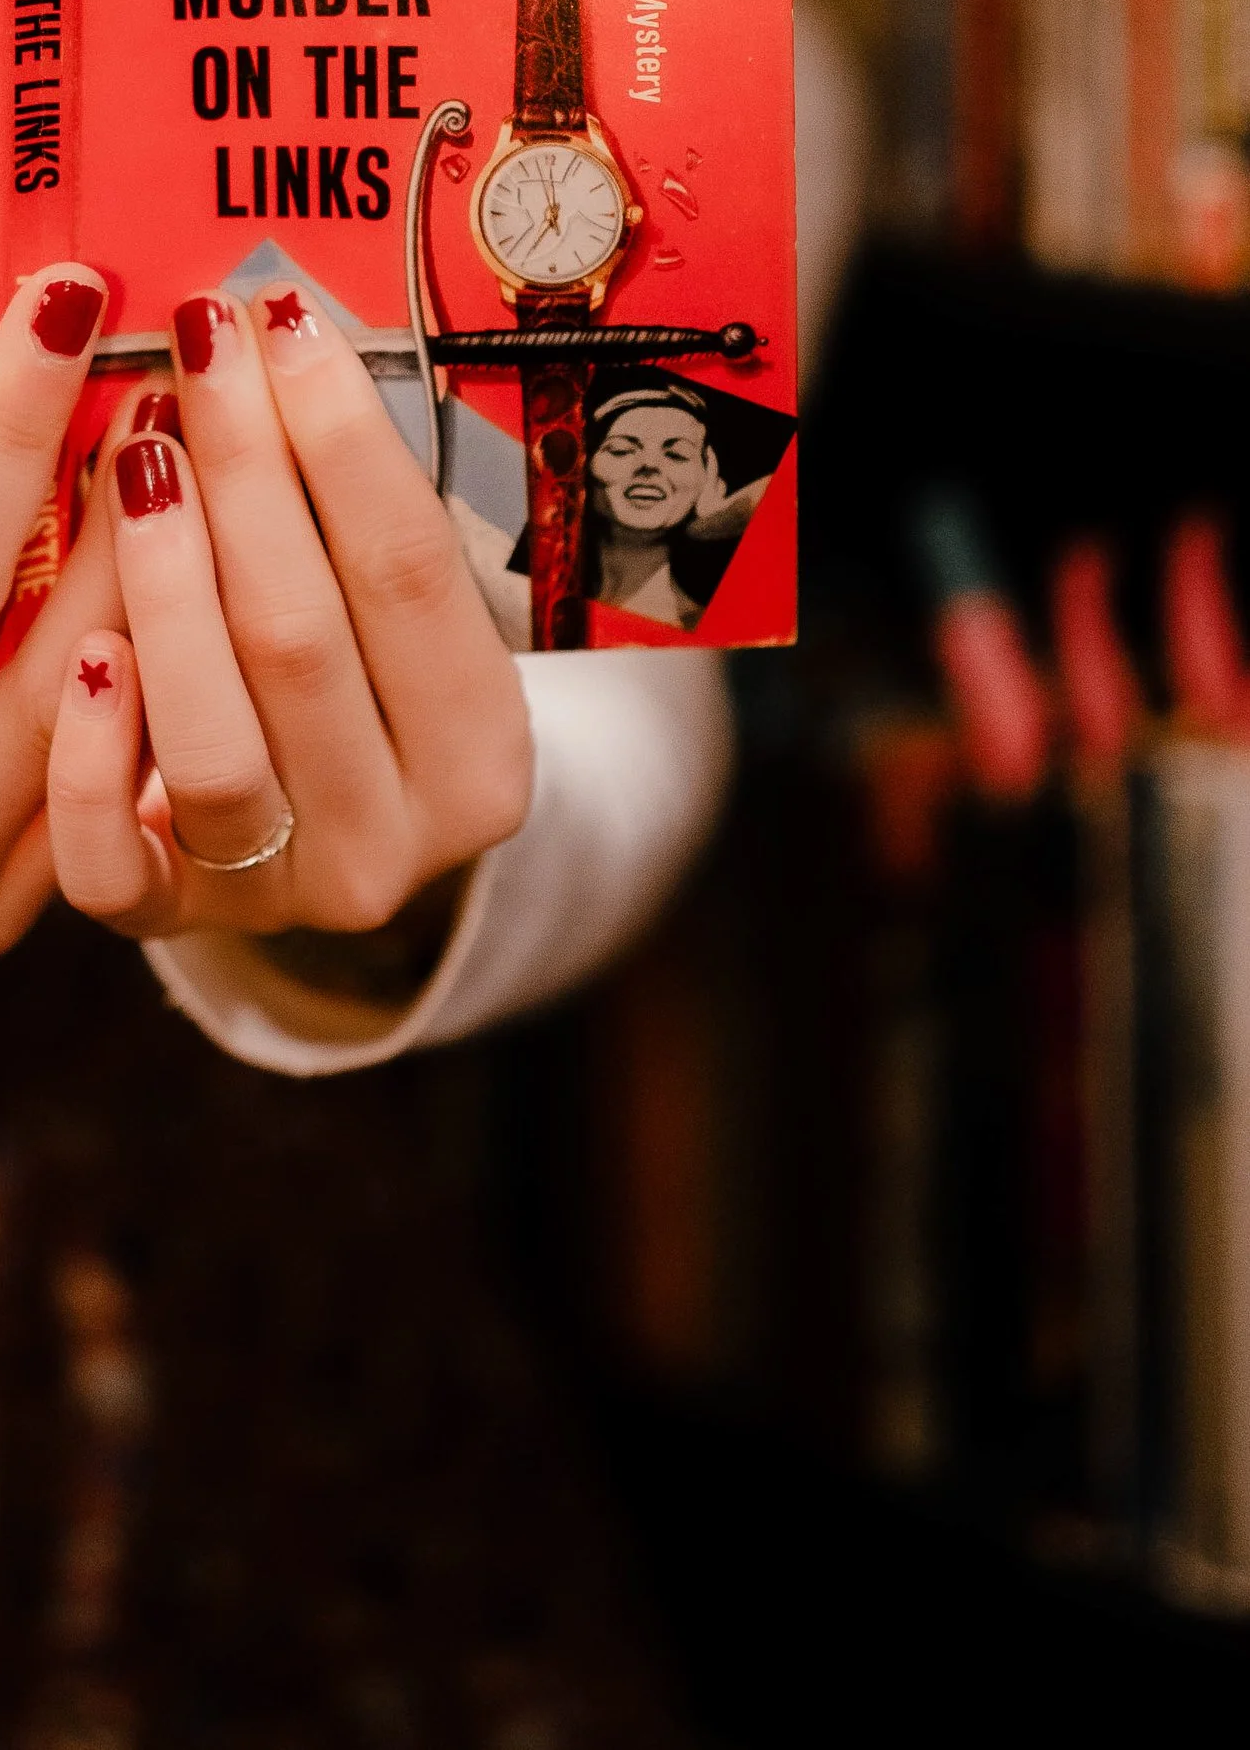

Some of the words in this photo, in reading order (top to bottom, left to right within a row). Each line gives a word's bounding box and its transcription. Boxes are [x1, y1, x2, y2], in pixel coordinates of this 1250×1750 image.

[192, 46, 271, 120] ON
[305, 45, 420, 119] THE
[14, 80, 60, 194] LINKS
[216, 146, 391, 220] LINKS
